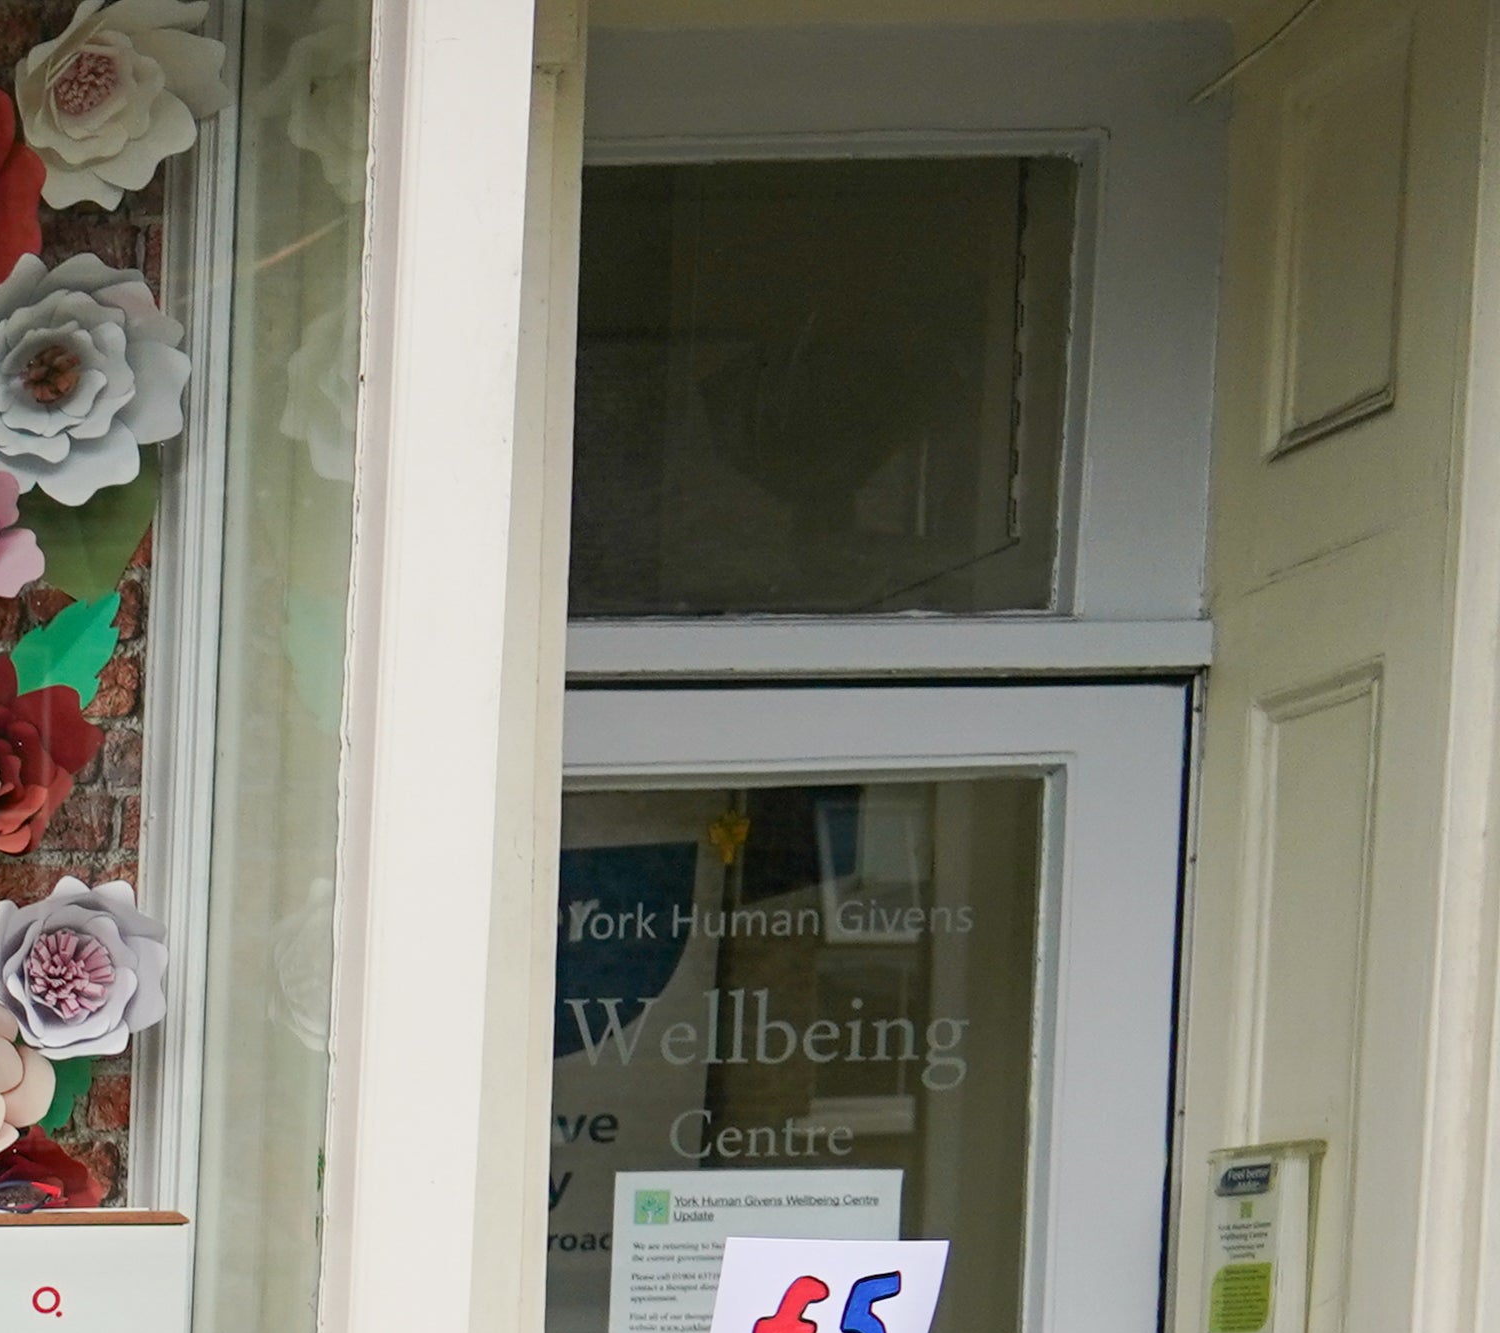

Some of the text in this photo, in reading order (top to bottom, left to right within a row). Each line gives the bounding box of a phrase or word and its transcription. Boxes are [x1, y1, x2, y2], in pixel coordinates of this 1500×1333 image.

[566, 898, 974, 941] York Human Givens
[564, 989, 970, 1092] Wellbeing
[669, 1108, 855, 1159] Centre
[673, 1210, 715, 1223] Update
[674, 1195, 699, 1208] York
[843, 1193, 879, 1206] Centre
